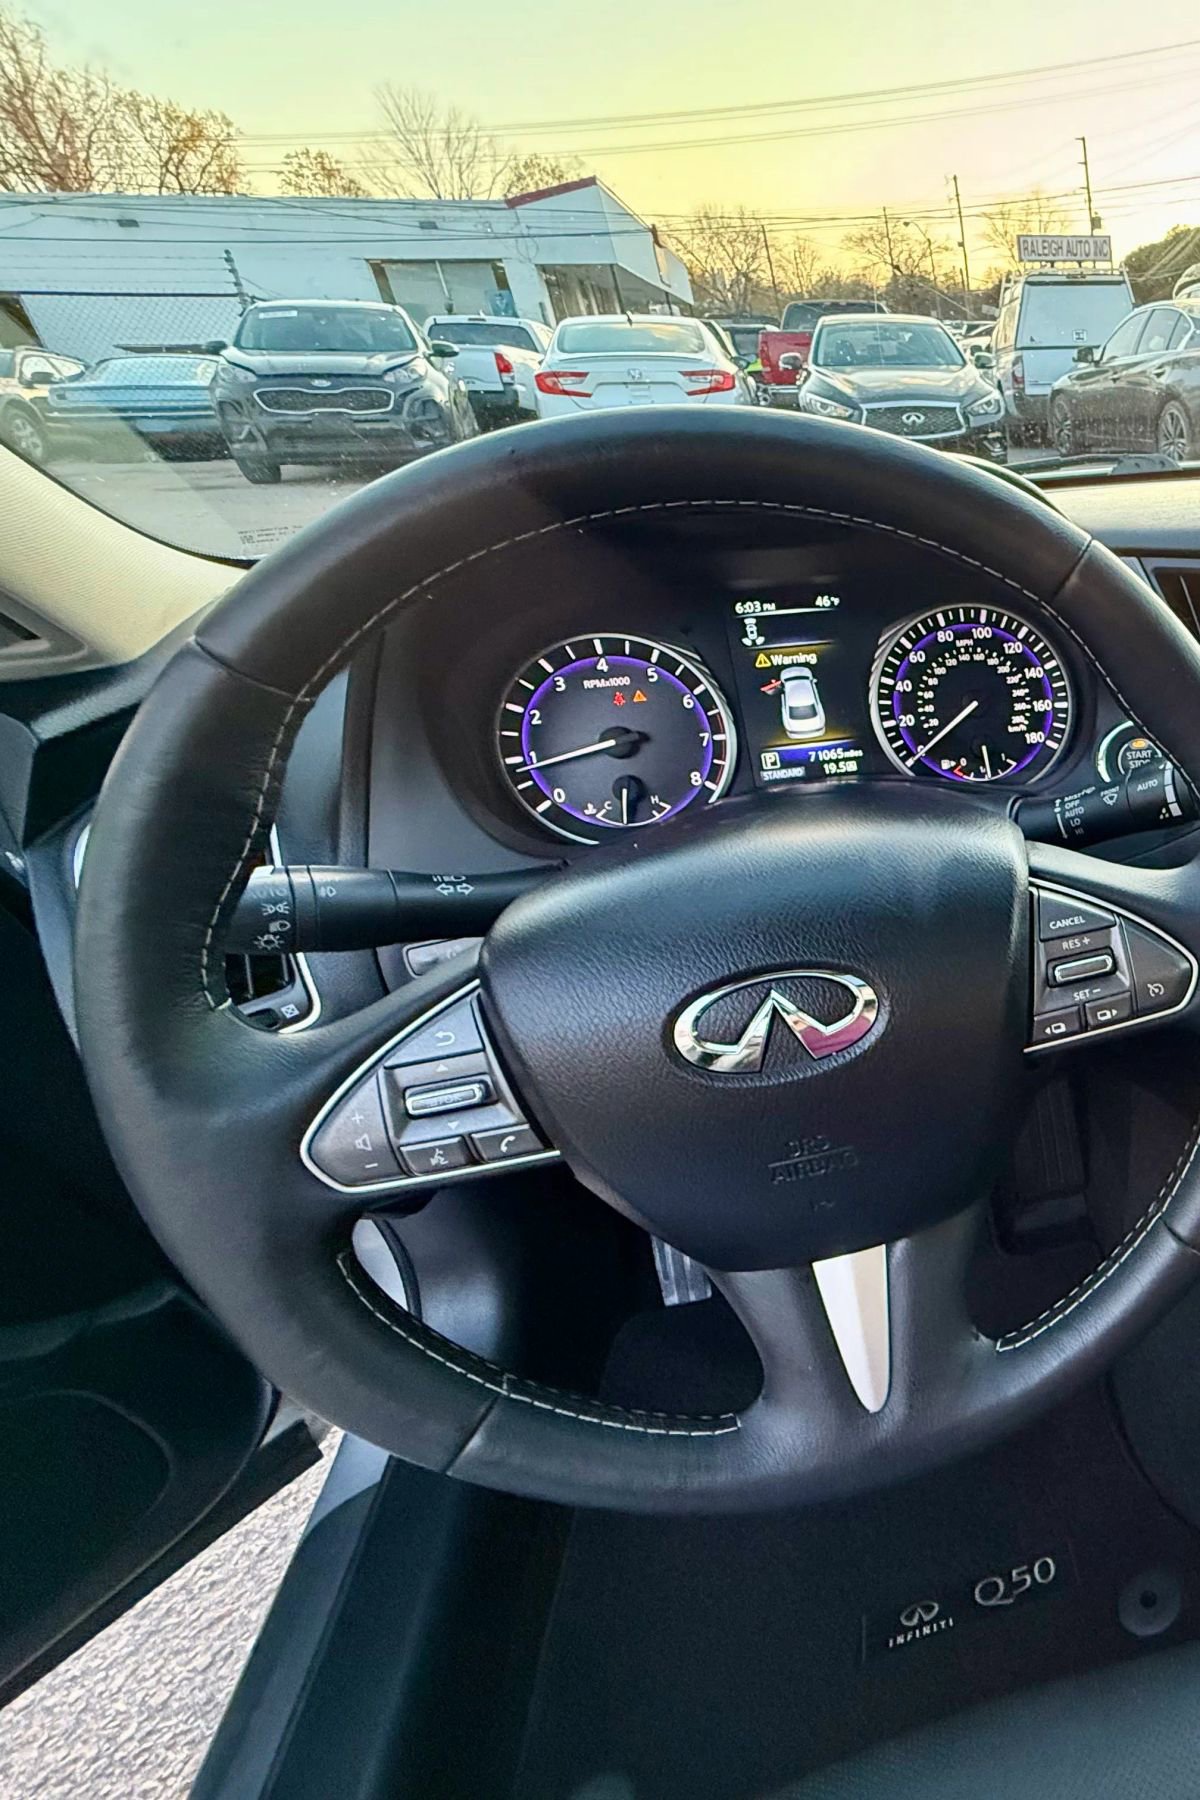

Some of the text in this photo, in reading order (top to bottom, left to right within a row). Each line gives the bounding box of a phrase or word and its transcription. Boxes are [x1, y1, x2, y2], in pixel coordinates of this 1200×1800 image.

[1022, 239, 1109, 257] RALEIGH AUTO INC
[735, 601, 761, 614] 6:03
[937, 630, 954, 642] 80
[972, 627, 993, 639] 100
[1003, 642, 1023, 654] 120
[770, 653, 818, 666] Warning
[909, 651, 926, 663] 60
[596, 658, 608, 672] 4
[933, 667, 947, 675] 100
[647, 668, 658, 682] 5
[1024, 667, 1044, 679] 140
[554, 676, 566, 691] 3
[583, 676, 631, 689] RPMx1000
[896, 680, 912, 692] 40
[682, 695, 694, 709] 6
[1033, 699, 1053, 712] 160
[529, 709, 542, 725] 2
[899, 718, 915, 727] 20
[699, 732, 710, 747] 7
[1025, 732, 1045, 744] 180
[529, 751, 537, 764] 1
[1126, 750, 1152, 760] START
[690, 771, 702, 786] 8
[1137, 779, 1158, 792] AUTO
[553, 788, 565, 803] 0
[650, 796, 659, 804] H
[604, 801, 612, 810] C
[1065, 800, 1080, 810] OFF
[1065, 807, 1084, 818] AUTO
[1070, 818, 1081, 827] LO
[1049, 915, 1086, 930] CANCEL
[1062, 939, 1081, 951] RES
[1073, 988, 1090, 1001] SET
[974, 1556, 1055, 1606] Q50
[889, 1617, 954, 1648] INFINITI
